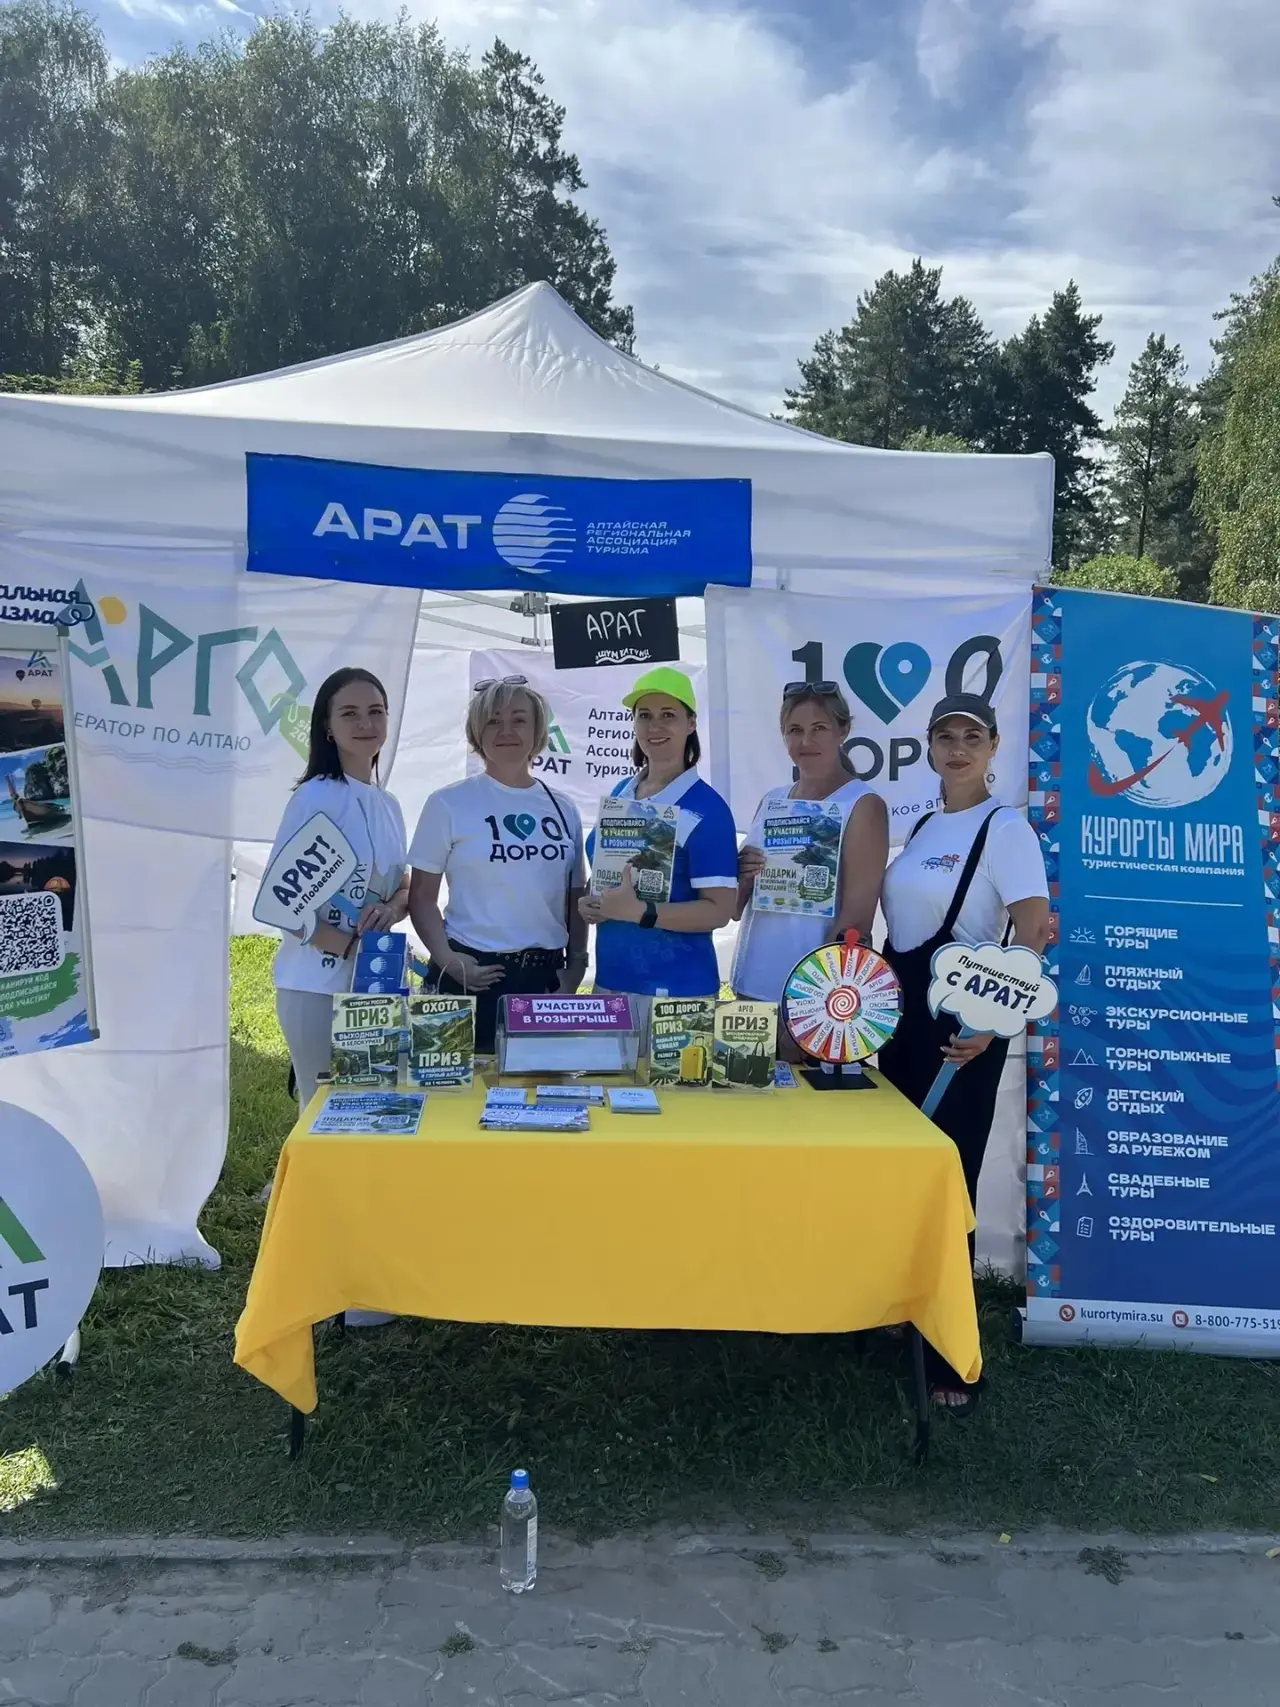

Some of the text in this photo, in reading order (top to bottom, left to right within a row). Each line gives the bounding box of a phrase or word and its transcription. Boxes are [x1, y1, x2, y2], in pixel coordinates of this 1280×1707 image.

[312, 501, 482, 550] АРАТ
[586, 520, 667, 530] АЛТАЙСКАЯ
[586, 529, 692, 538] РЕГИОНАЛЬНАЯ
[586, 536, 678, 547] АССОЦИАЦИЯ
[586, 545, 650, 555] ТУРИЗМА
[586, 608, 647, 641] АРАТ
[28, 669, 54, 677] АРАТ
[153, 726, 181, 744] ПО
[609, 827, 639, 837] УЧАСТВУЙ
[773, 826, 804, 835] УЧАСТВУЙ
[609, 839, 646, 848] РОЗЫГРЫШЕ
[772, 836, 811, 846] РОЗЫГРЫШЕ
[1081, 814, 1244, 864] КУРОРТЫ МИРА
[489, 843, 569, 863] ДОРОГ
[272, 834, 336, 907] АРАТ!
[760, 868, 797, 879] ПОДАРКИ
[1081, 858, 1245, 876] туристическая компания
[293, 900, 305, 916] не
[1104, 925, 1178, 940] ГОРЯЩИЕ
[1105, 937, 1149, 950] ТУРЫ
[957, 955, 1041, 993] Путешествуй
[1105, 965, 1183, 980] ПЛЯЖНЫЙ
[1105, 977, 1162, 991] ОТДЫХ
[964, 974, 1037, 1015] АРАТ!
[422, 1000, 459, 1014] ОХОТА
[536, 1001, 601, 1011] УЧАСТВУЙ
[660, 1003, 701, 1015] 100 ДОРОГ
[738, 1004, 754, 1013] АРГО
[345, 1007, 389, 1028] ПРИЗ
[523, 1015, 618, 1024] В РОЗЫГРЫШЕ
[1105, 1006, 1248, 1023] ЭКСКУРСИОННЫЕ
[655, 1021, 683, 1035] ПРИЗ
[722, 1015, 769, 1030] ПРИЗ
[1105, 1018, 1151, 1031] ТУРЫ
[338, 1030, 380, 1040] ВЫХОДНЫЕ
[418, 1052, 462, 1067] ПРИЗ
[1105, 1047, 1231, 1064] ГОРНОЛЫЖНЫЕ
[1106, 1059, 1152, 1072] ТУРЫ
[347, 1076, 353, 1084] 2
[1106, 1088, 1185, 1103] ДЕТСКИЙ
[1107, 1101, 1165, 1115] ОТДЫХ
[1107, 1130, 1229, 1147] ОБРАЗОВАНИЕ
[1108, 1173, 1210, 1188] СВАДЕБНЫЕ
[1108, 1186, 1155, 1199] ТУРЫ
[1108, 1216, 1276, 1235] ОЗДОРОВИТЕЛЬНЫЕ
[1109, 1229, 1155, 1242] ТУРЫ
[1080, 1307, 1164, 1323] kurortymira.su
